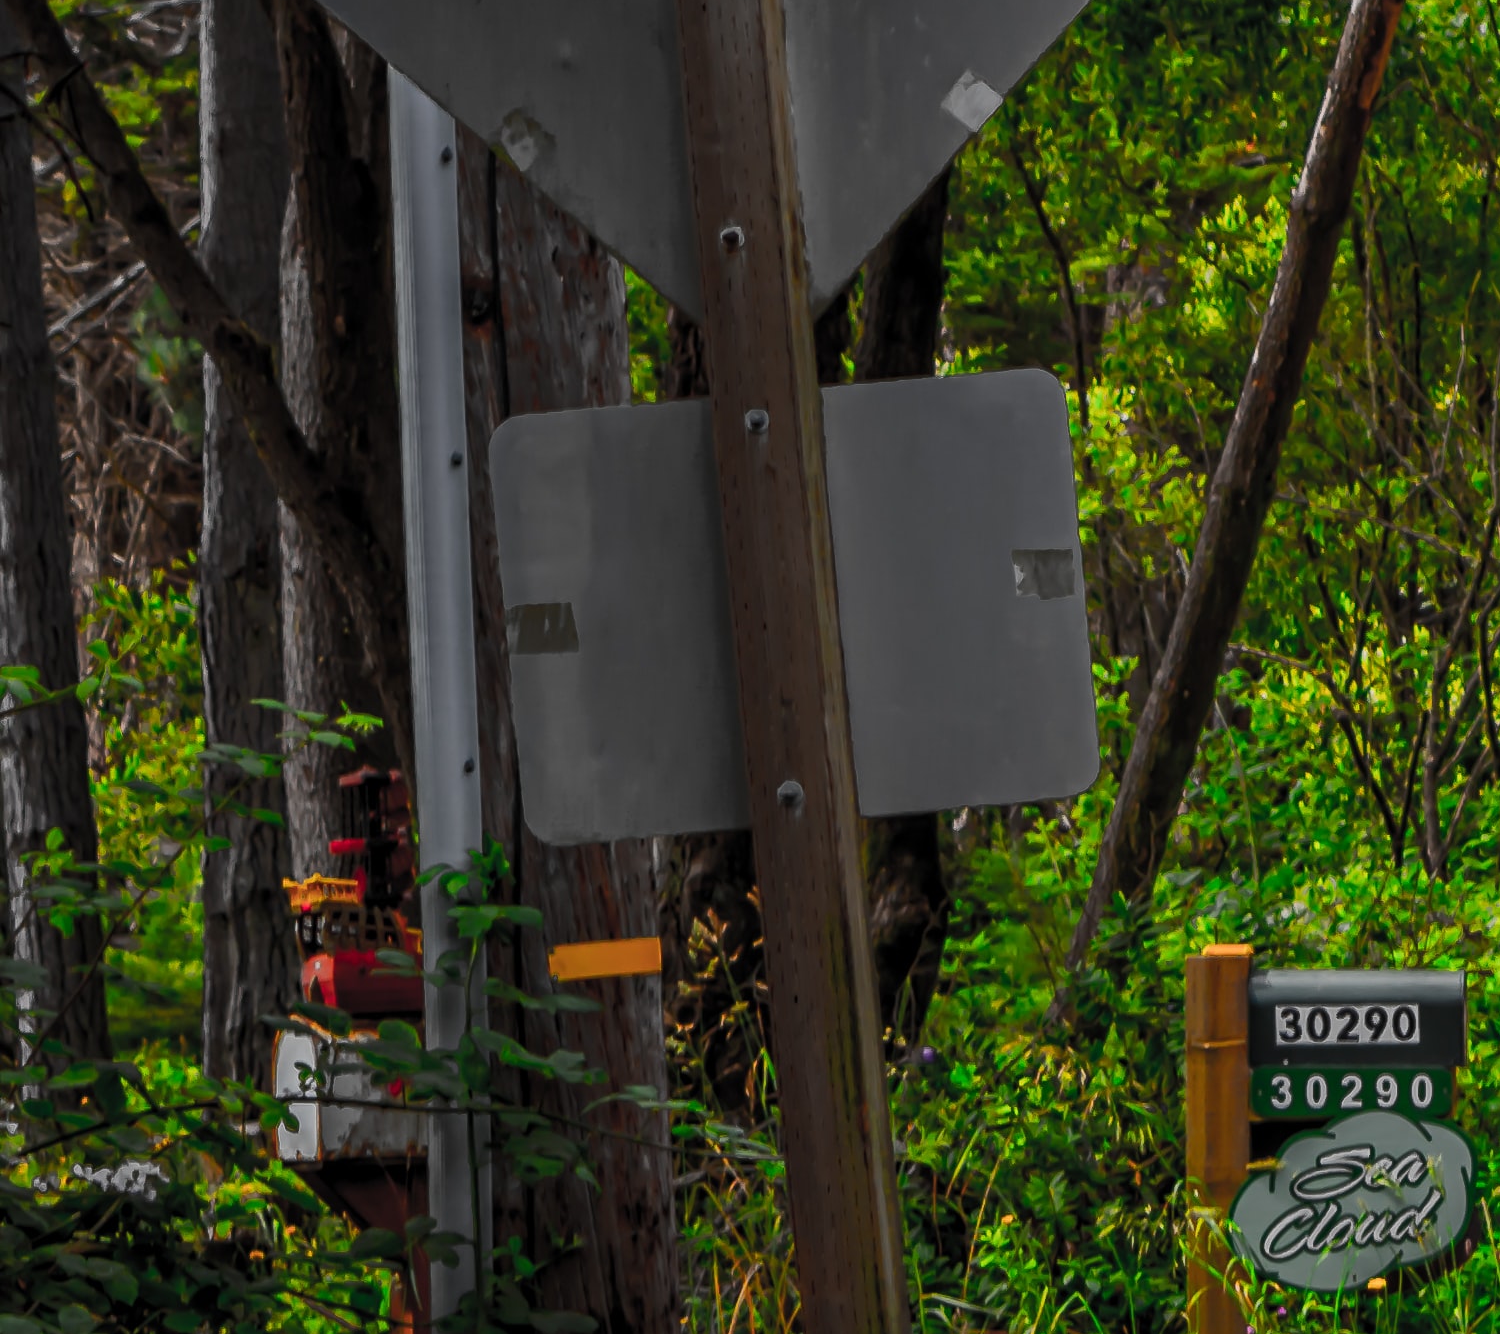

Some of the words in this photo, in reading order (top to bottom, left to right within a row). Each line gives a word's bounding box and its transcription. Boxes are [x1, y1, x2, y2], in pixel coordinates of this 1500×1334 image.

[1279, 1005, 1417, 1044] 30290
[1271, 1074, 1434, 1110] 30290
[1292, 1144, 1427, 1202] Sea
[1262, 1187, 1443, 1260] Cloud
